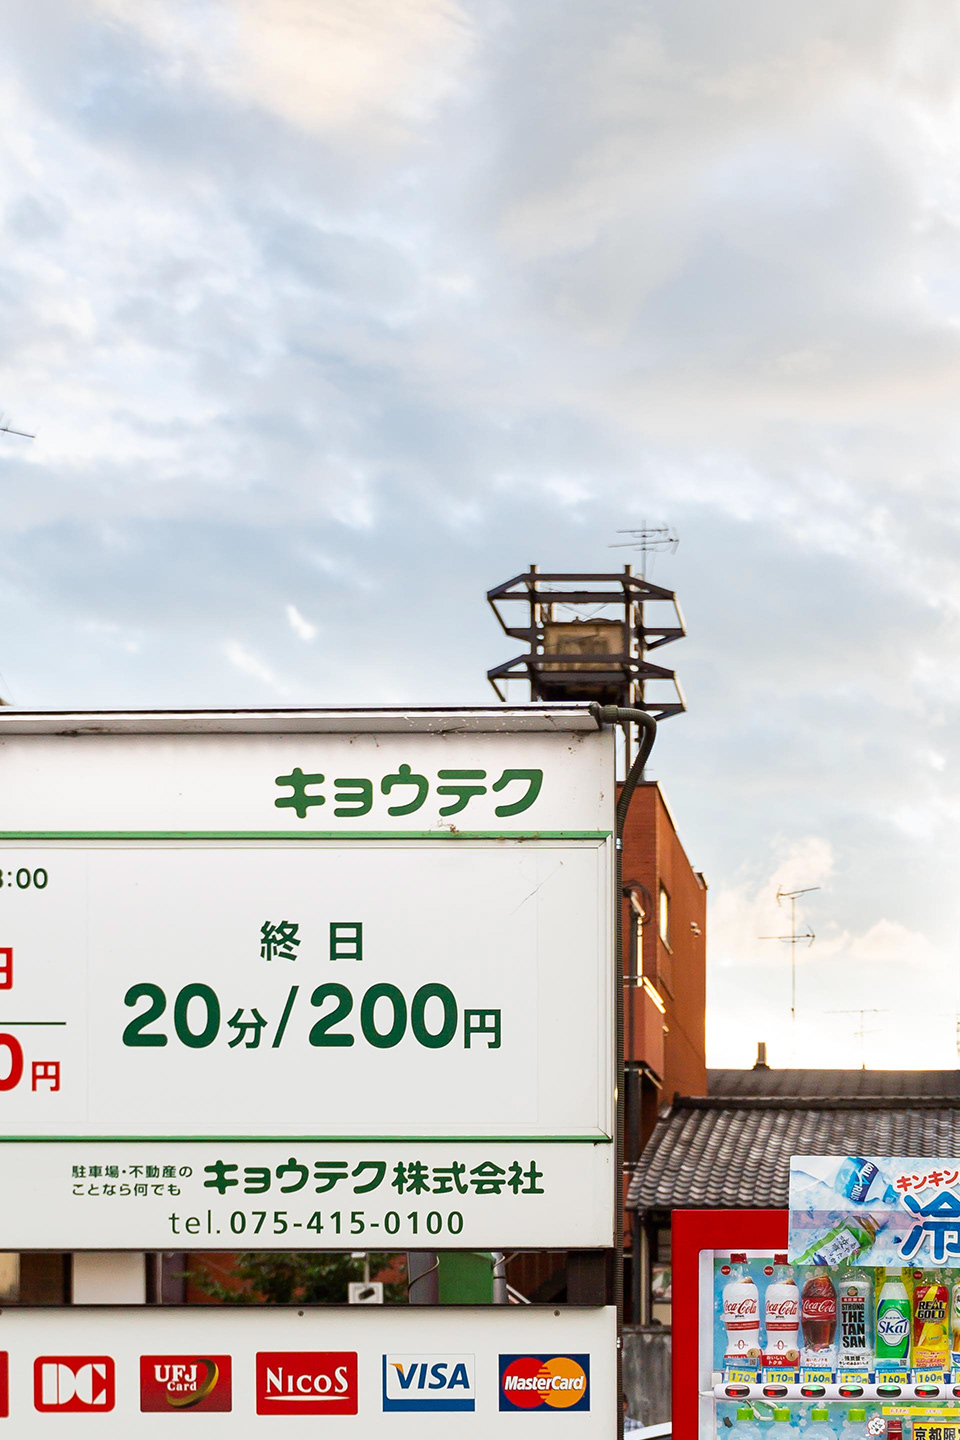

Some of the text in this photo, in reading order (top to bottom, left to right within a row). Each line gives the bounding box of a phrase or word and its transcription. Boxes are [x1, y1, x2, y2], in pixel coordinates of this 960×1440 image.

[275, 764, 544, 819] キョウテク
[259, 921, 364, 962] 終日
[122, 982, 502, 1050] 20分/200円
[72, 1165, 193, 1179] 駐車場・不動産の
[203, 1157, 545, 1196] キョウテク株式会社
[72, 1184, 182, 1197] ことなら何でも
[724, 1299, 757, 1315] Coca-Cola
[766, 1300, 798, 1315] Coca-Cola
[802, 1300, 836, 1314] Coca-Cola
[842, 1311, 864, 1323] THE
[842, 1323, 865, 1335] TAN
[843, 1336, 865, 1348] SAN
[154, 1365, 198, 1382] UFJ
[389, 1363, 470, 1389] VISA
[770, 1373, 794, 1383] 170円
[807, 1374, 830, 1383] 160円
[882, 1375, 905, 1383] 160円
[919, 1374, 942, 1382] 160円
[42, 1363, 106, 1405] DC
[167, 1381, 197, 1391] Card
[504, 1375, 584, 1391] MasterCard
